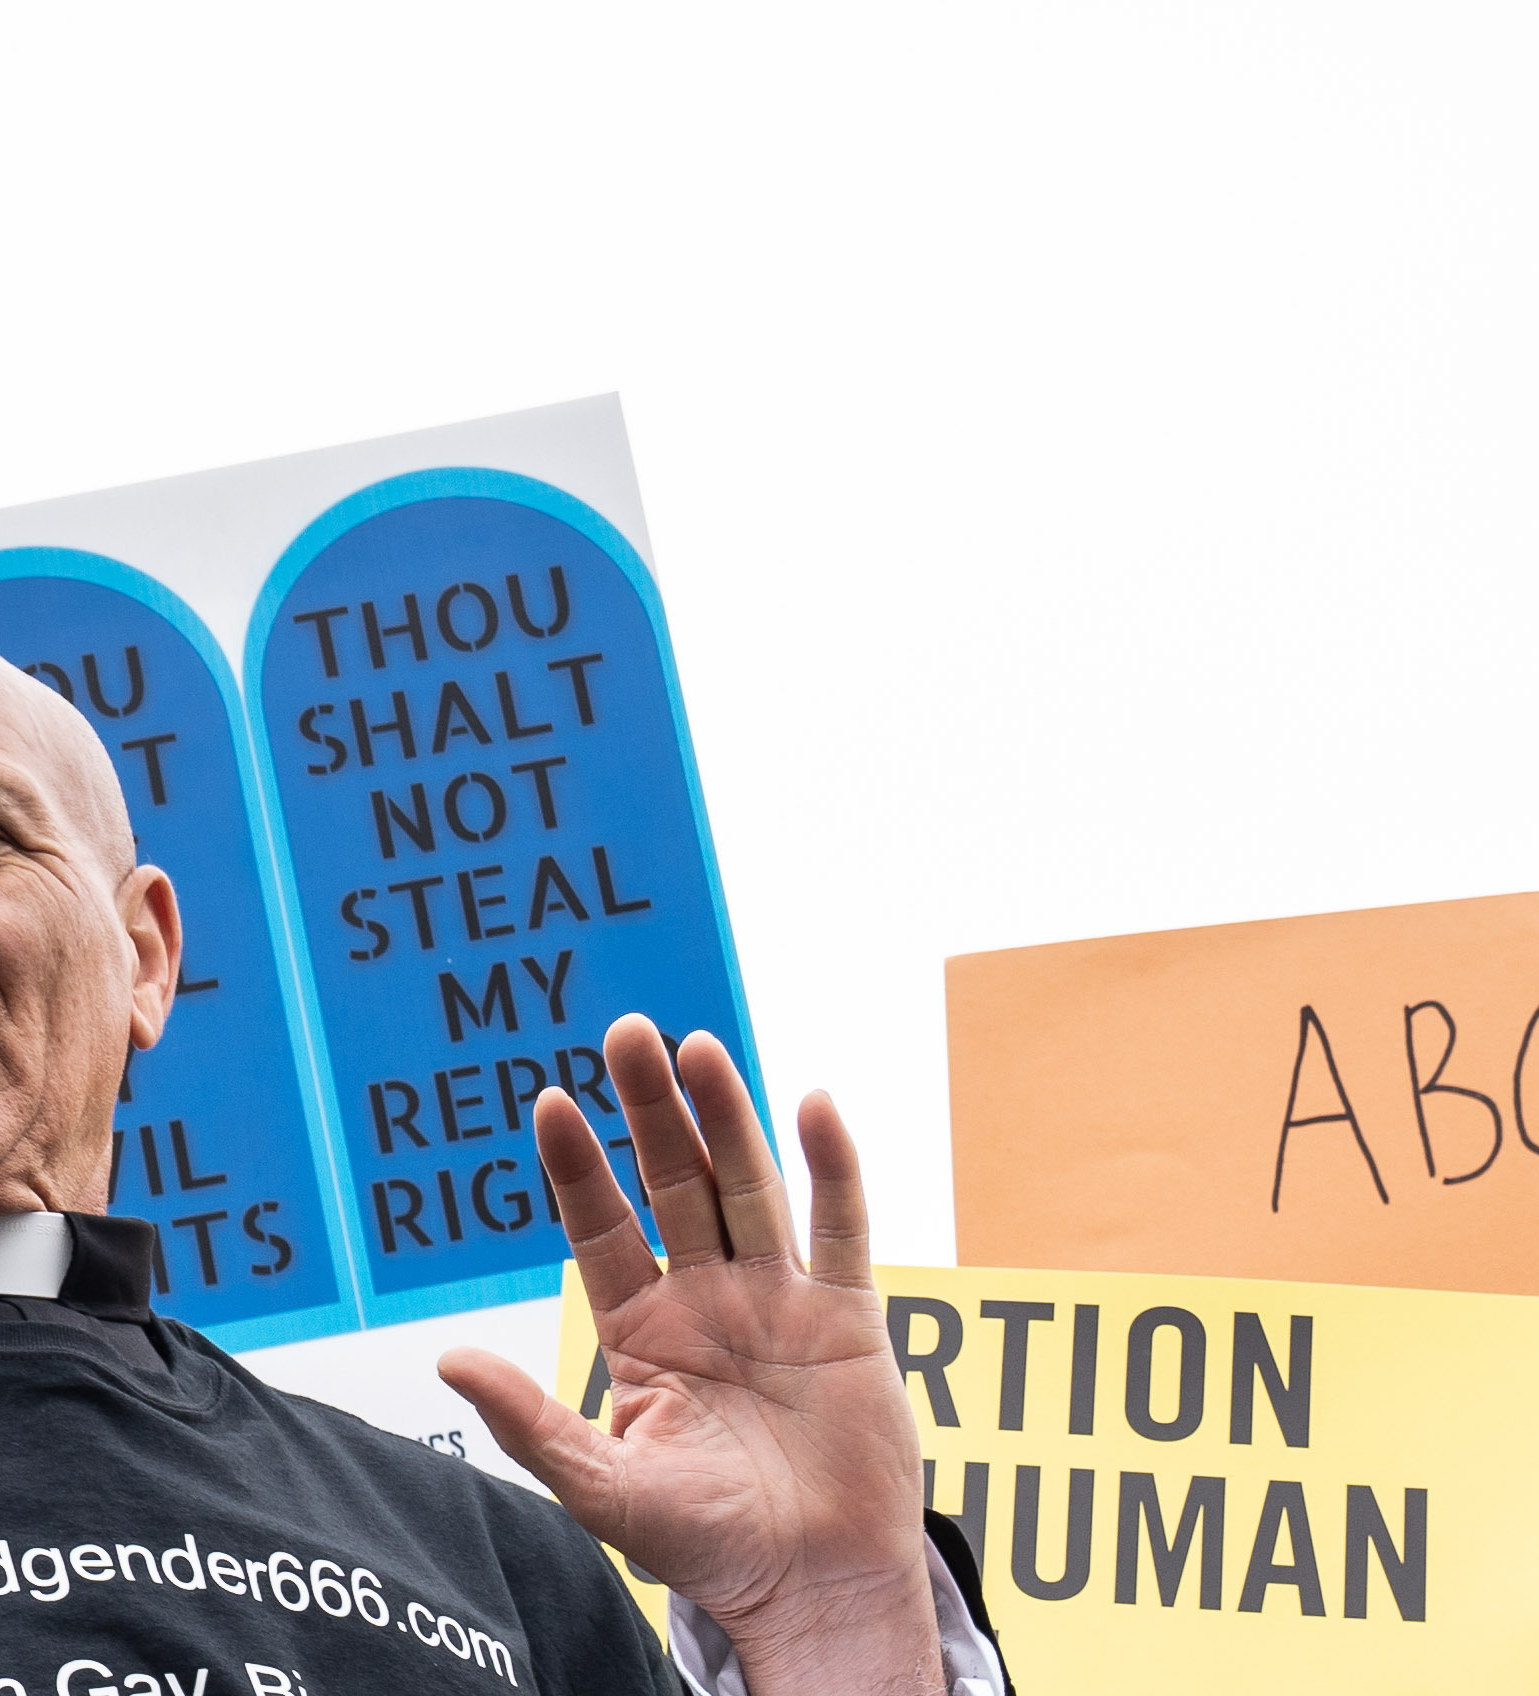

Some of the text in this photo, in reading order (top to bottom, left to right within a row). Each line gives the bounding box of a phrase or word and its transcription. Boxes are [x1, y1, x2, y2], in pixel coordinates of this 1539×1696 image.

[293, 565, 570, 678] THOU
[298, 653, 604, 776] SHALT
[370, 756, 567, 860] NOT
[341, 845, 651, 962] STEAL
[438, 950, 574, 1043] MY
[1272, 1000, 1539, 1213] AB
[578, 1294, 1315, 1449] RTION
